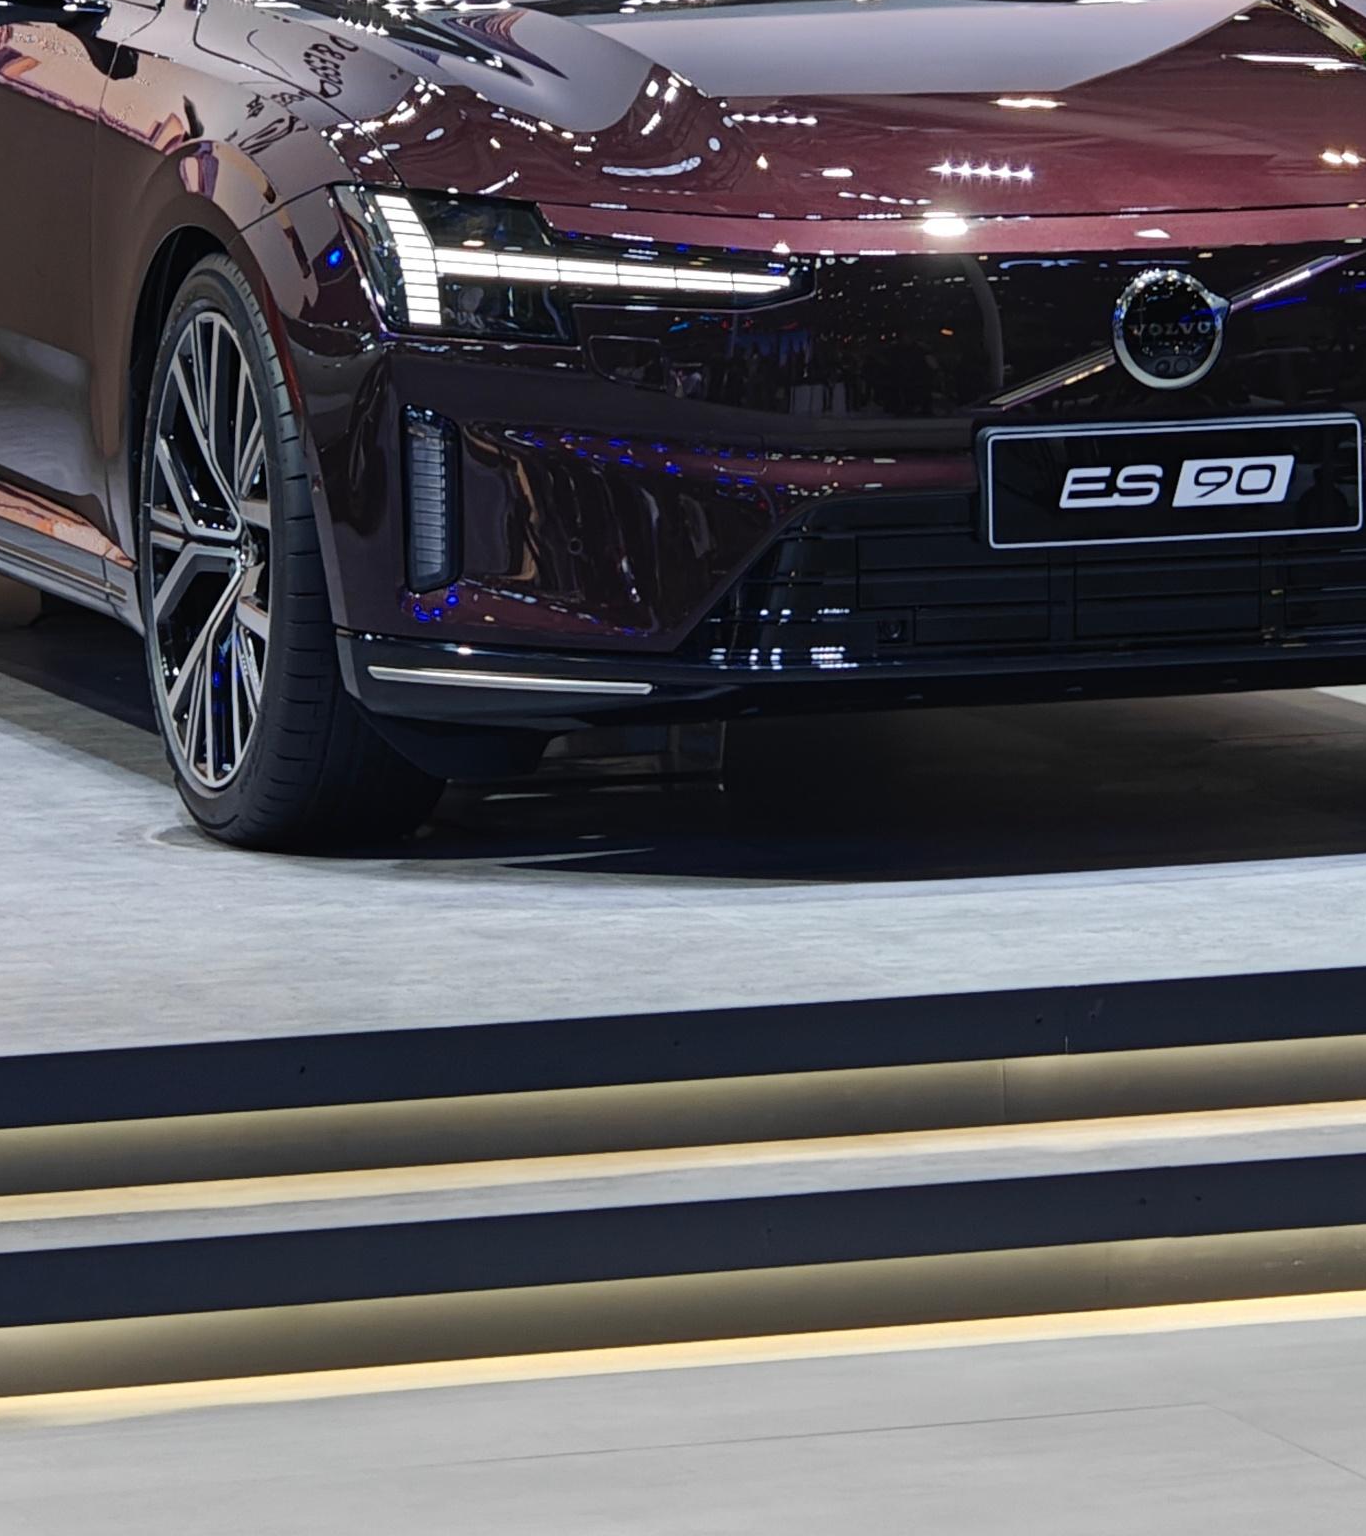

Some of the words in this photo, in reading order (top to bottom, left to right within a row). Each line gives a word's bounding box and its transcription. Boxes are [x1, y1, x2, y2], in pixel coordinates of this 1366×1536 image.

[1128, 319, 1212, 336] VOLVO
[1059, 464, 1164, 509] ES
[1191, 461, 1280, 501] 90
